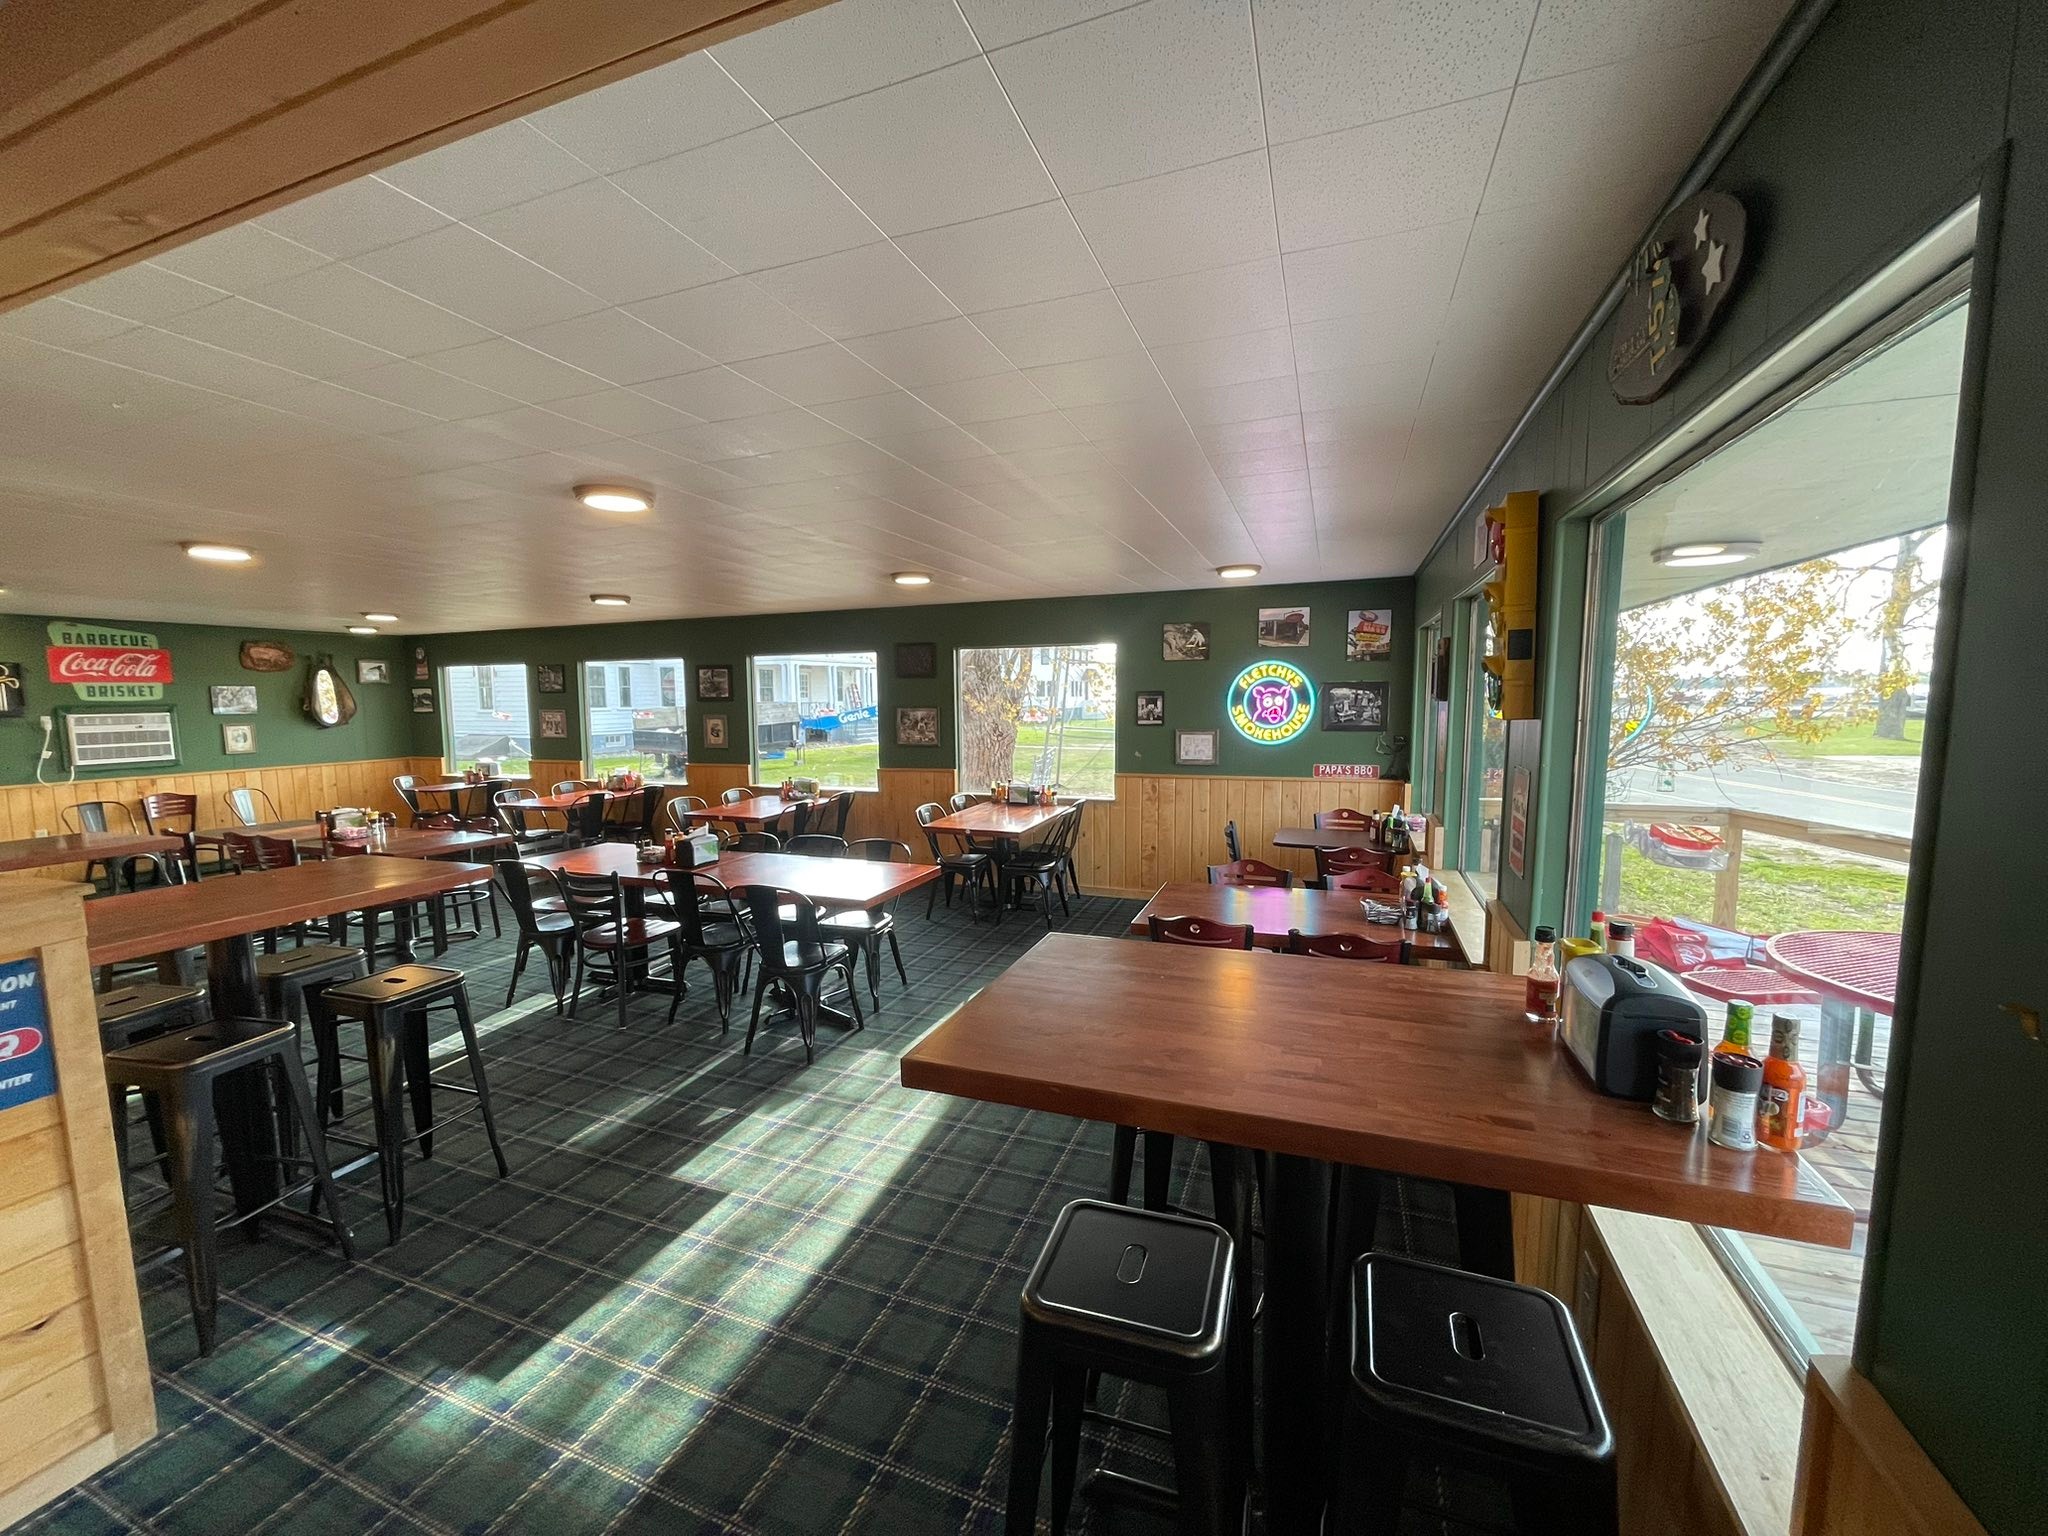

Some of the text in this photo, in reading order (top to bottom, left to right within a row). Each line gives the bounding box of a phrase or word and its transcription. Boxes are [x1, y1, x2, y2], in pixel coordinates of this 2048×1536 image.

[62, 632, 148, 647] BARBECUE
[59, 651, 162, 677] Coca-Cola
[1238, 664, 1303, 689] FLETCHYS
[86, 686, 155, 697] BRISKET
[838, 709, 870, 724] Genie
[1231, 703, 1310, 740] SMOKEHOUSE
[1319, 765, 1373, 775] PAPA'S BBQ
[0, 971, 36, 993] ON
